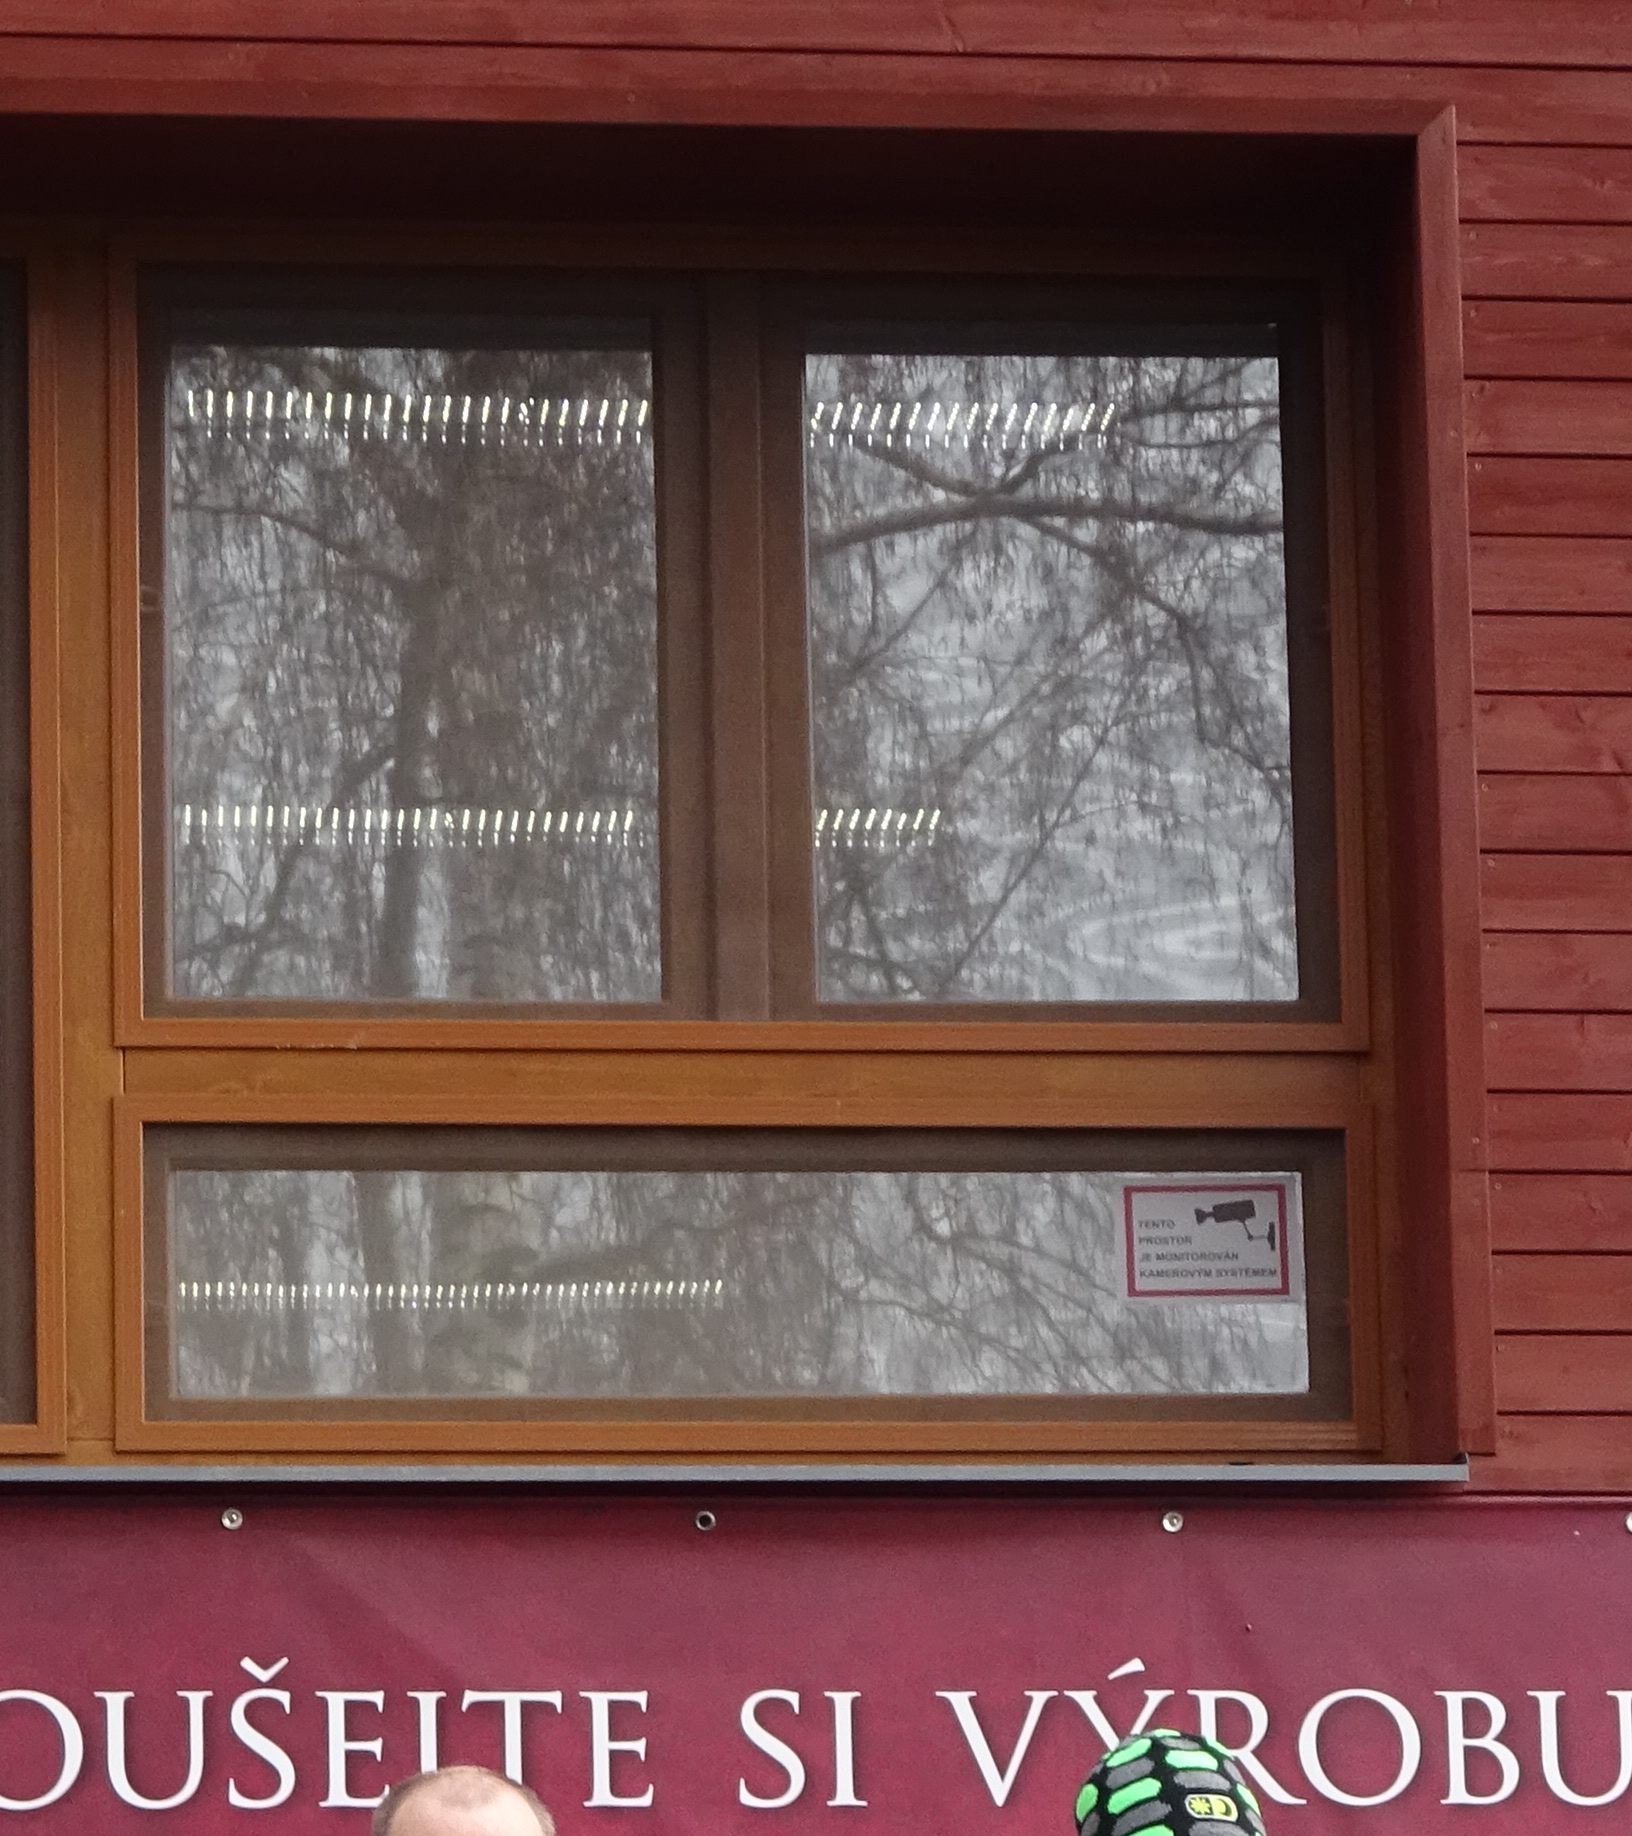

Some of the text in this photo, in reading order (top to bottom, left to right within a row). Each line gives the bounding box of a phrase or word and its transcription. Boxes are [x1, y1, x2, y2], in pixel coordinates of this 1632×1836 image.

[1138, 1219, 1176, 1230] TENTO
[1138, 1235, 1193, 1246] PROSTOR
[736, 1688, 870, 1808] SI
